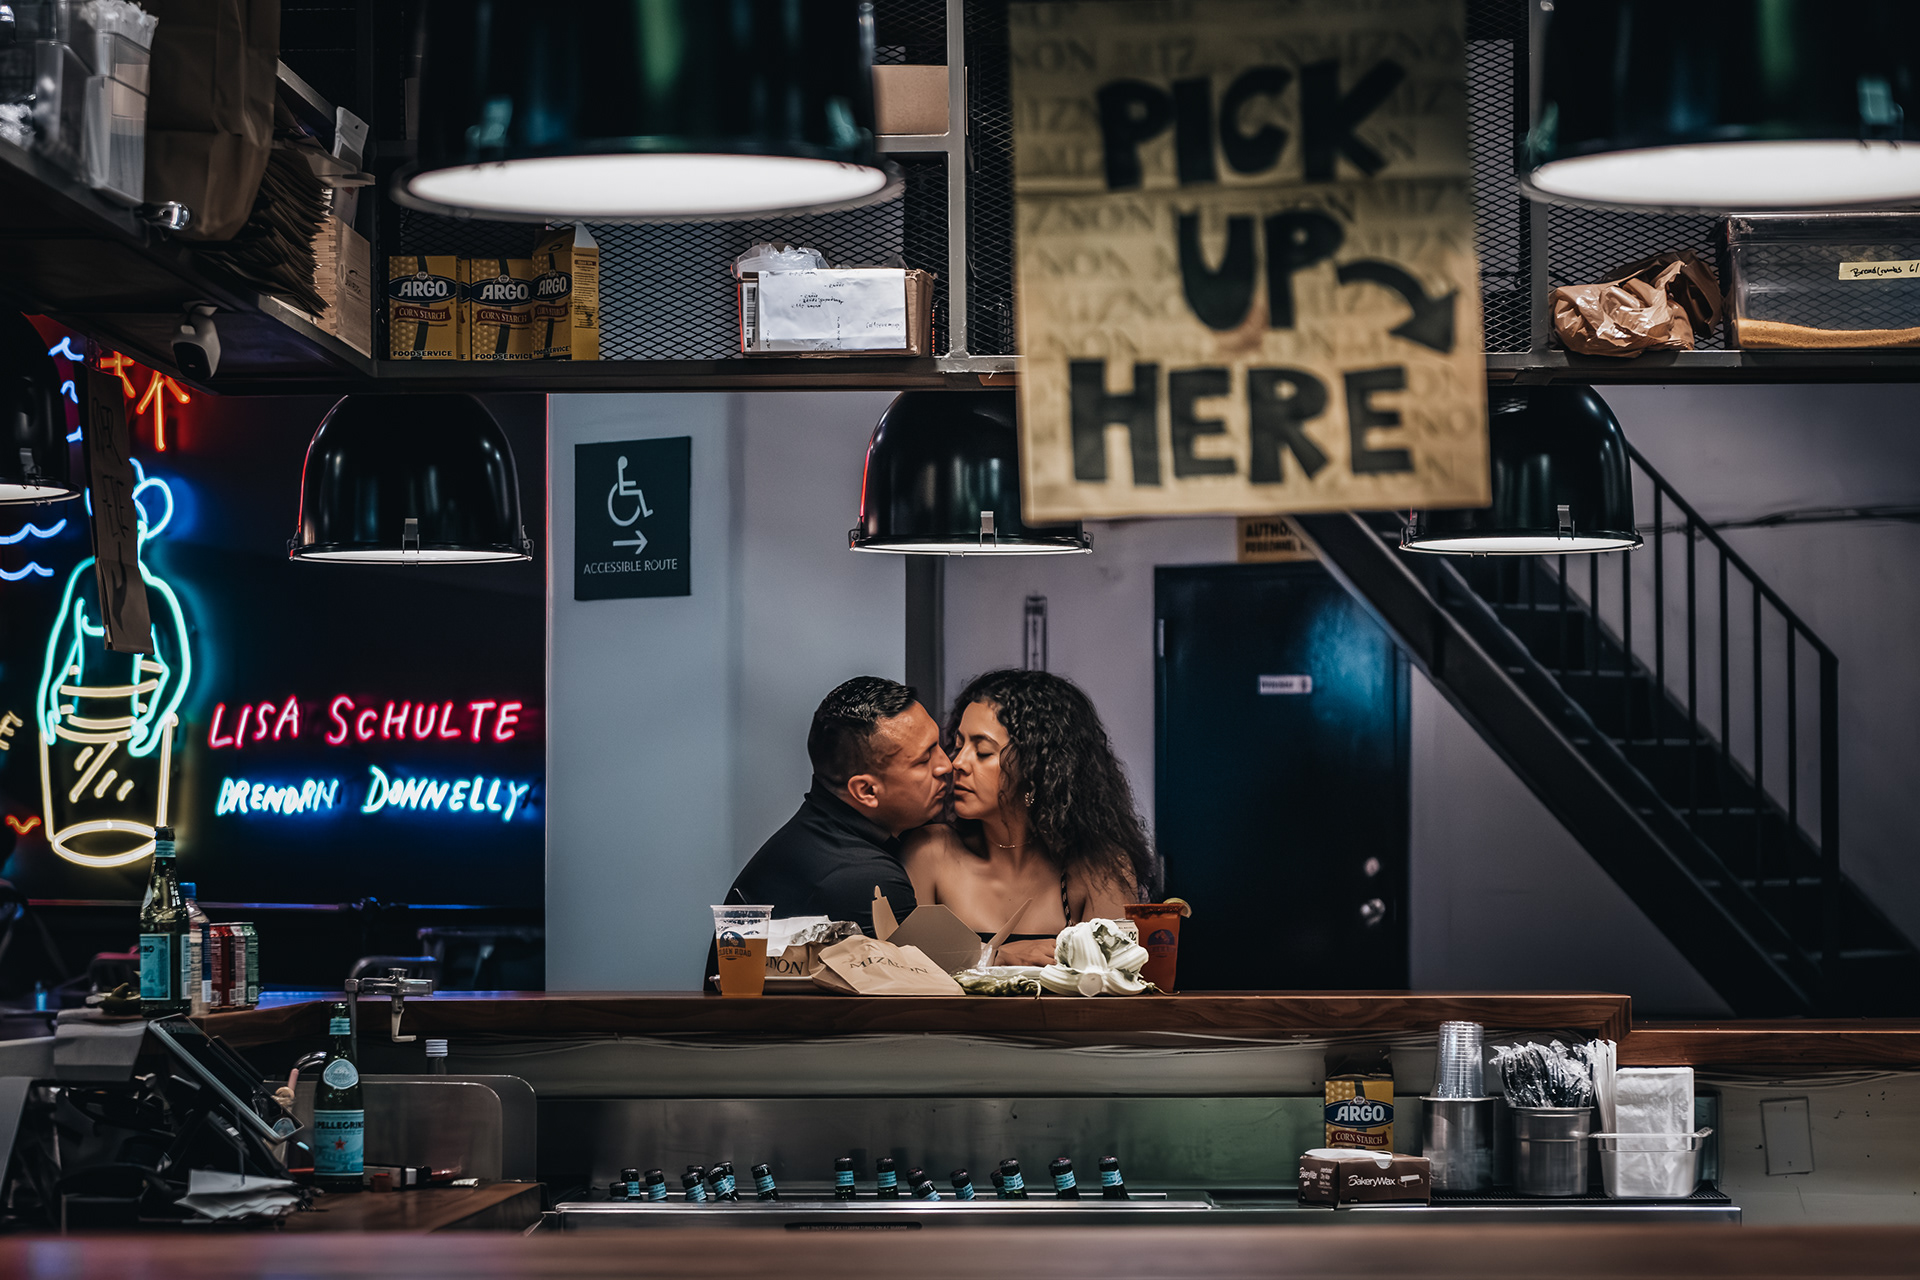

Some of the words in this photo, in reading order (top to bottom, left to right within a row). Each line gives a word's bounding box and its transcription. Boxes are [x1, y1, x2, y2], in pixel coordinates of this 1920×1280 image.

[1096, 58, 1406, 190] PICK
[1178, 208, 1344, 331] UP
[398, 307, 419, 318] CORN
[419, 309, 446, 320] STARCH
[480, 310, 500, 321] CORN
[500, 312, 528, 323] STARCH
[1070, 361, 1414, 485] HERE
[583, 560, 641, 575] ACCESSIBLE
[644, 558, 678, 571] ROUTE
[208, 694, 299, 748] LISA
[325, 692, 522, 747] SCHULTE
[360, 764, 530, 823] DONNELLY
[1335, 1131, 1356, 1142] CORN
[1357, 1133, 1383, 1145] STARCH
[1348, 1174, 1396, 1187] BakeryWax
